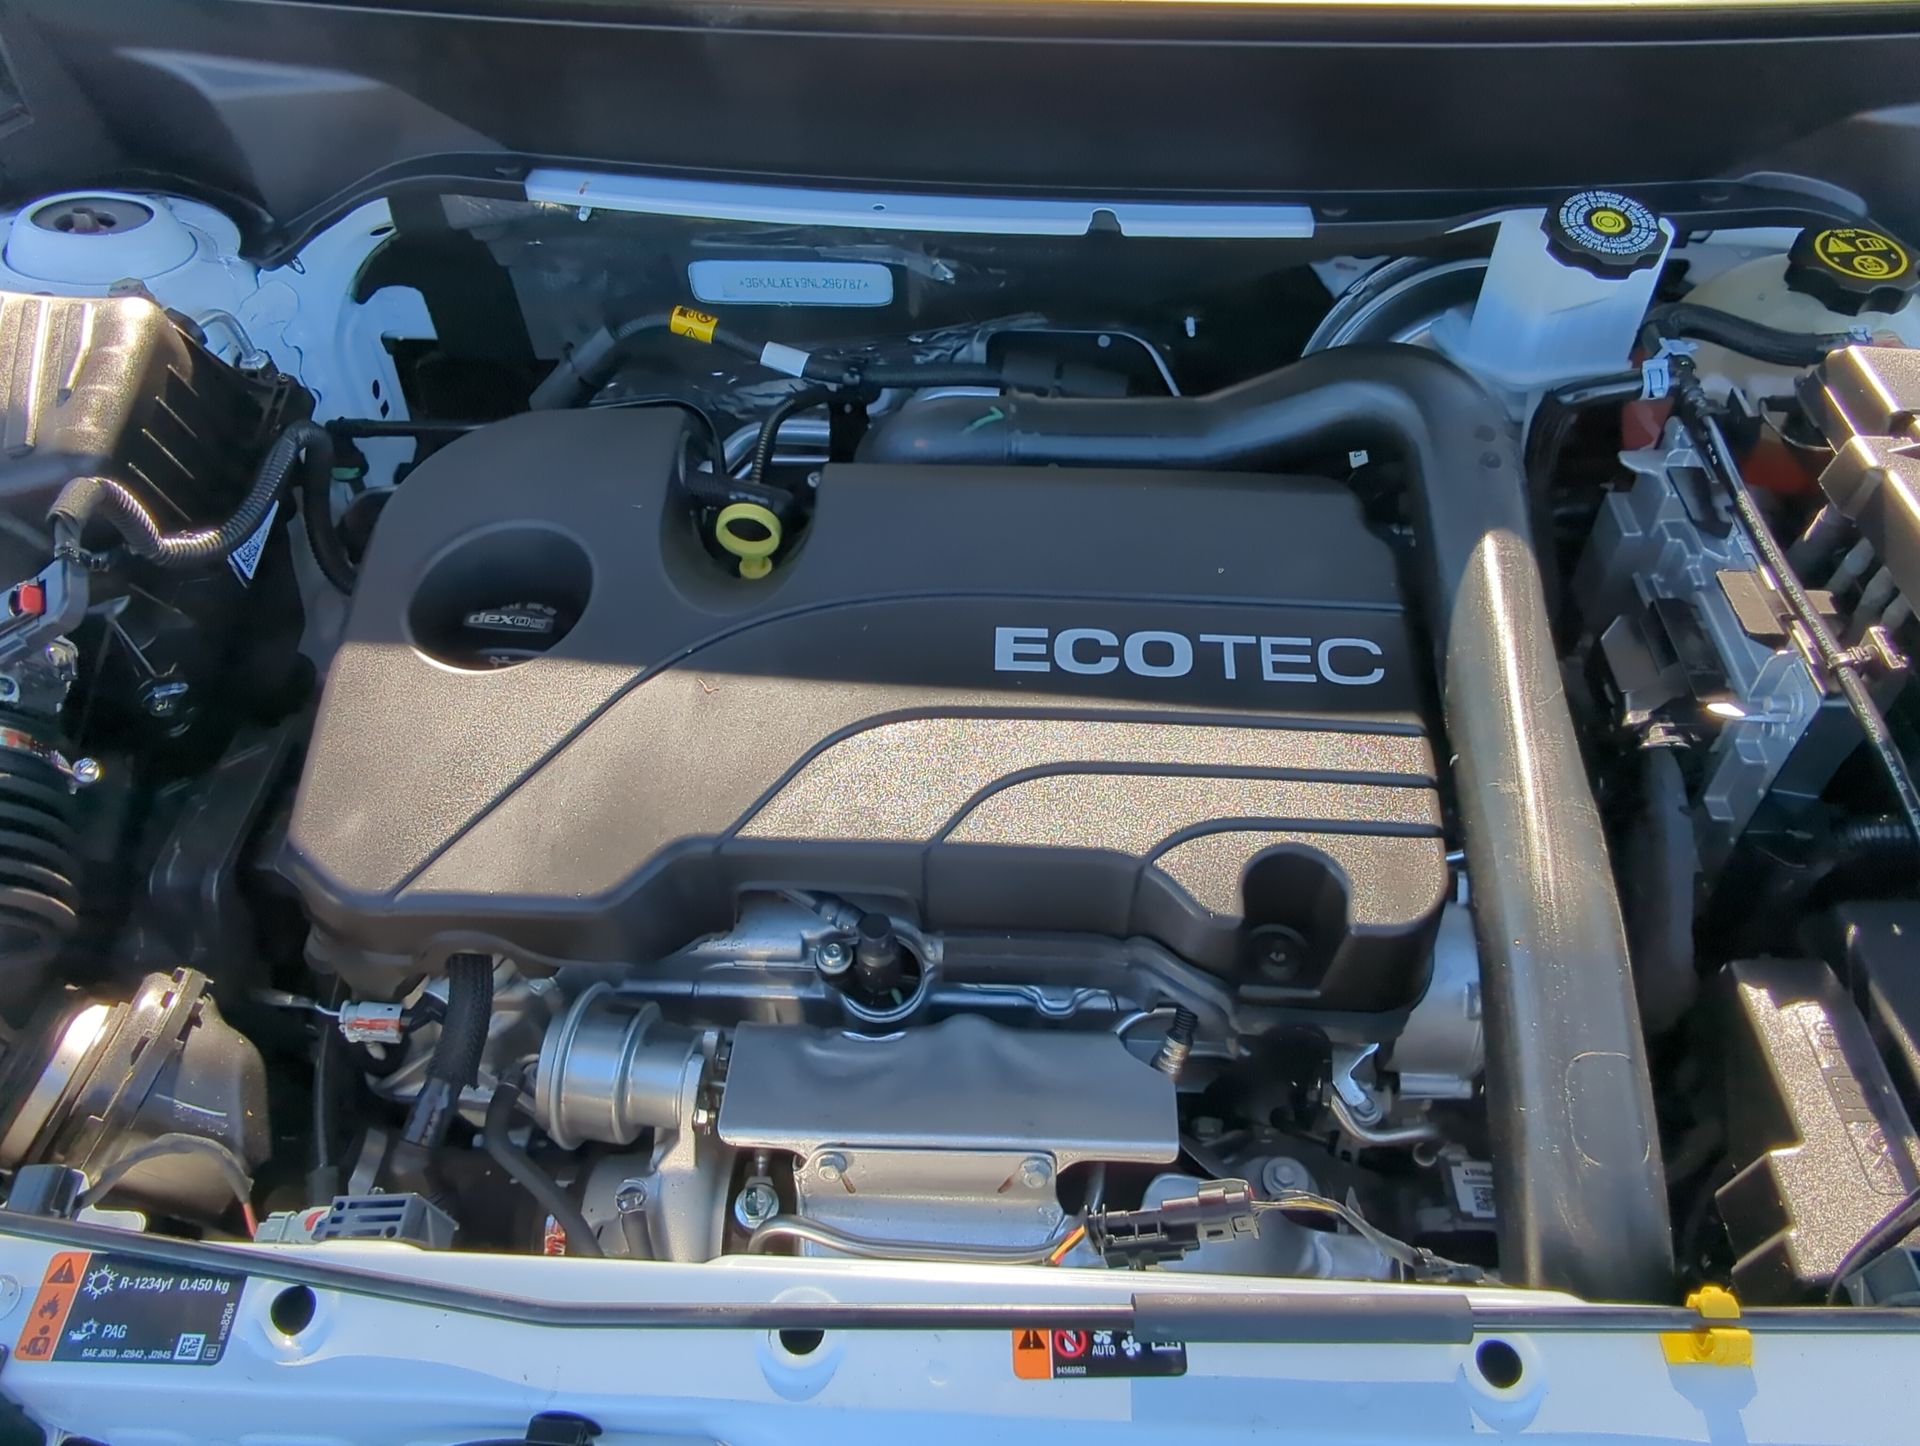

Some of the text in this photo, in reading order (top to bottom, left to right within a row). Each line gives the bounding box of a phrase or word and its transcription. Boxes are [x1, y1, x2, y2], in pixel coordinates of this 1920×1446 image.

[994, 626, 1385, 686] ECOTEC
[119, 1276, 230, 1295] R-1234yf 0.450 kg
[101, 1323, 128, 1339] PAG
[1091, 1345, 1116, 1356] AUTO
